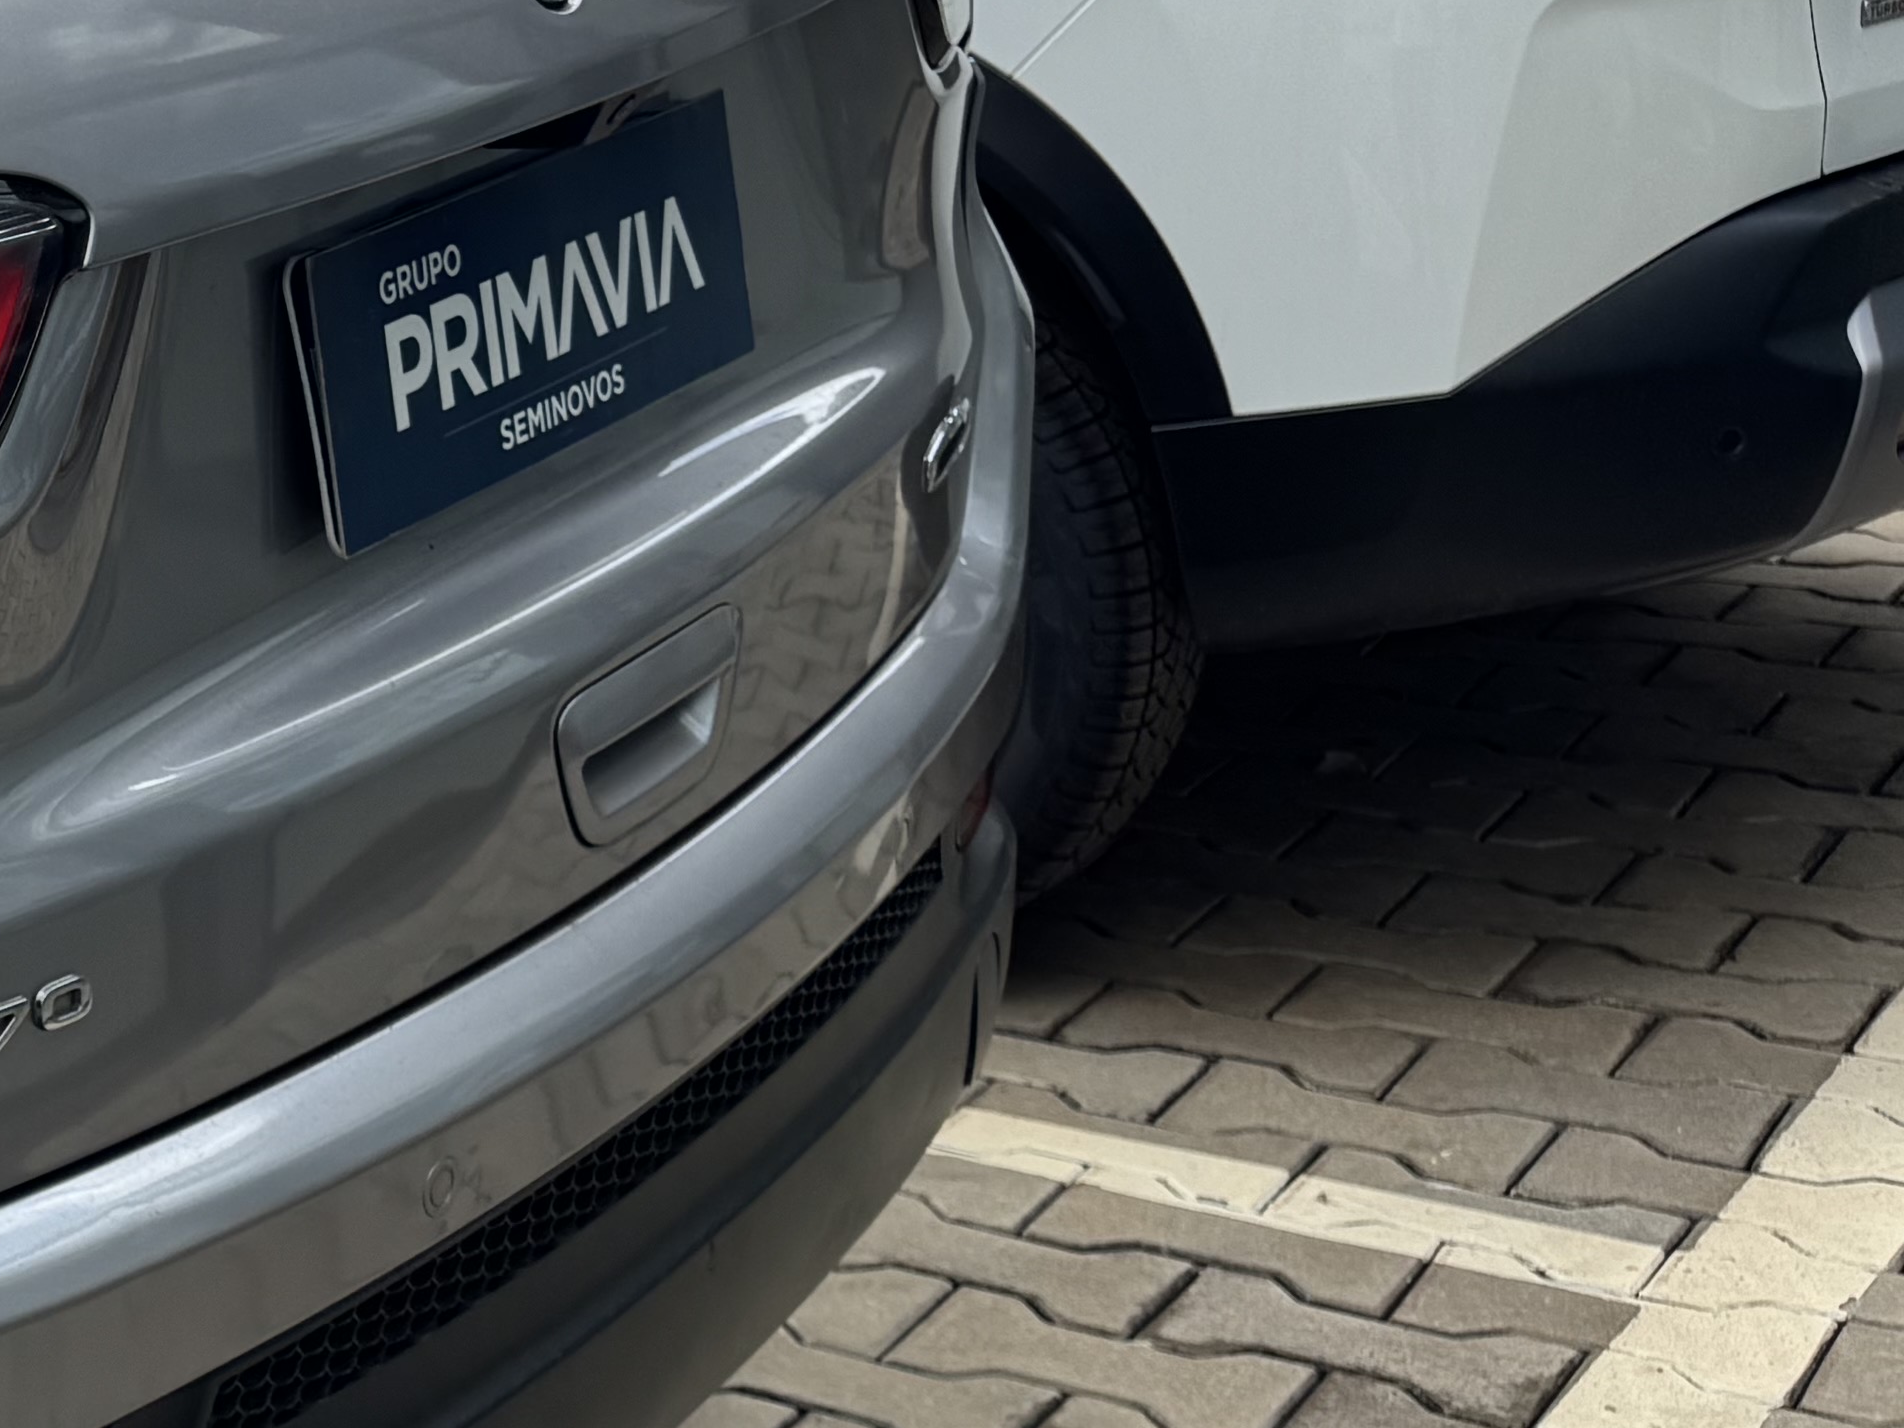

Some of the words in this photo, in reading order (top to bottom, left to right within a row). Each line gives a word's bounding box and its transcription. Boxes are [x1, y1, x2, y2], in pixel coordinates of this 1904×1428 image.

[379, 243, 462, 305] GRUPO
[383, 195, 706, 433] PRIMAVIA
[499, 363, 625, 452] SEMINOVOS
